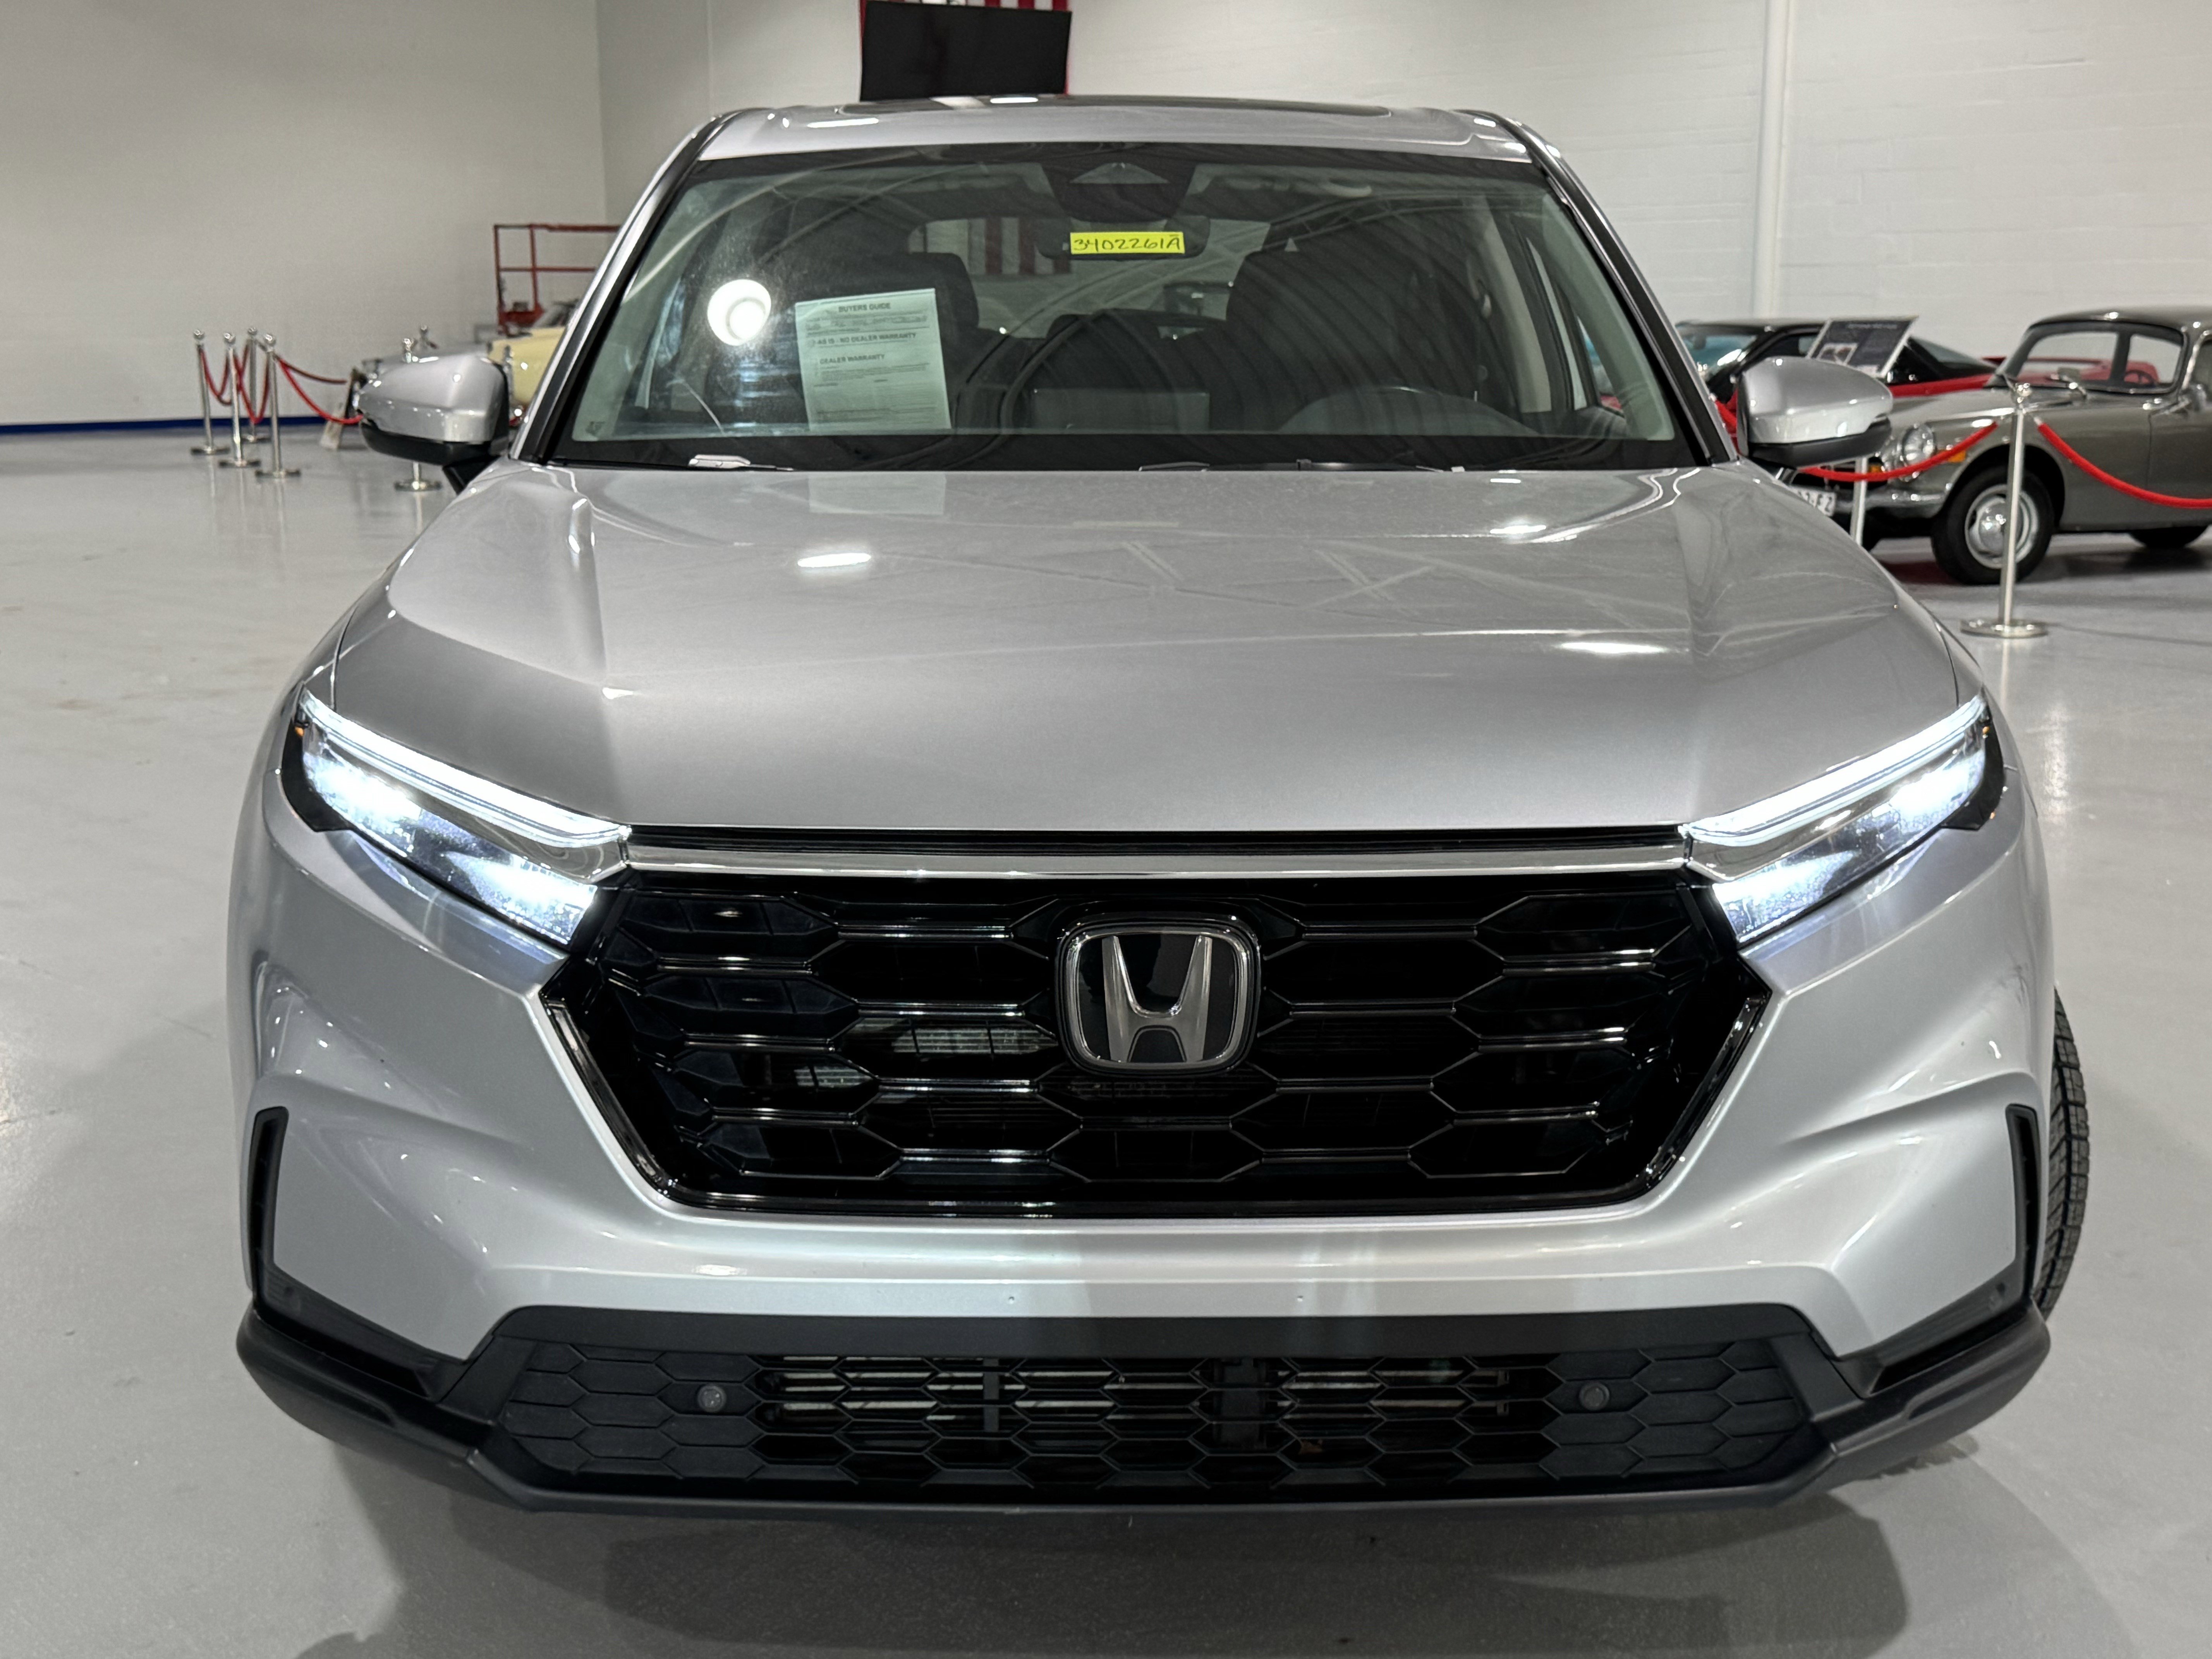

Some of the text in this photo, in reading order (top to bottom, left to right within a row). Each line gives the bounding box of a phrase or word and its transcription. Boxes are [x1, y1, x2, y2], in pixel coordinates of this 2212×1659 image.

[1073, 234, 1180, 252] 3402261A
[838, 304, 867, 312] BUYERS
[819, 356, 846, 364] DEALER
